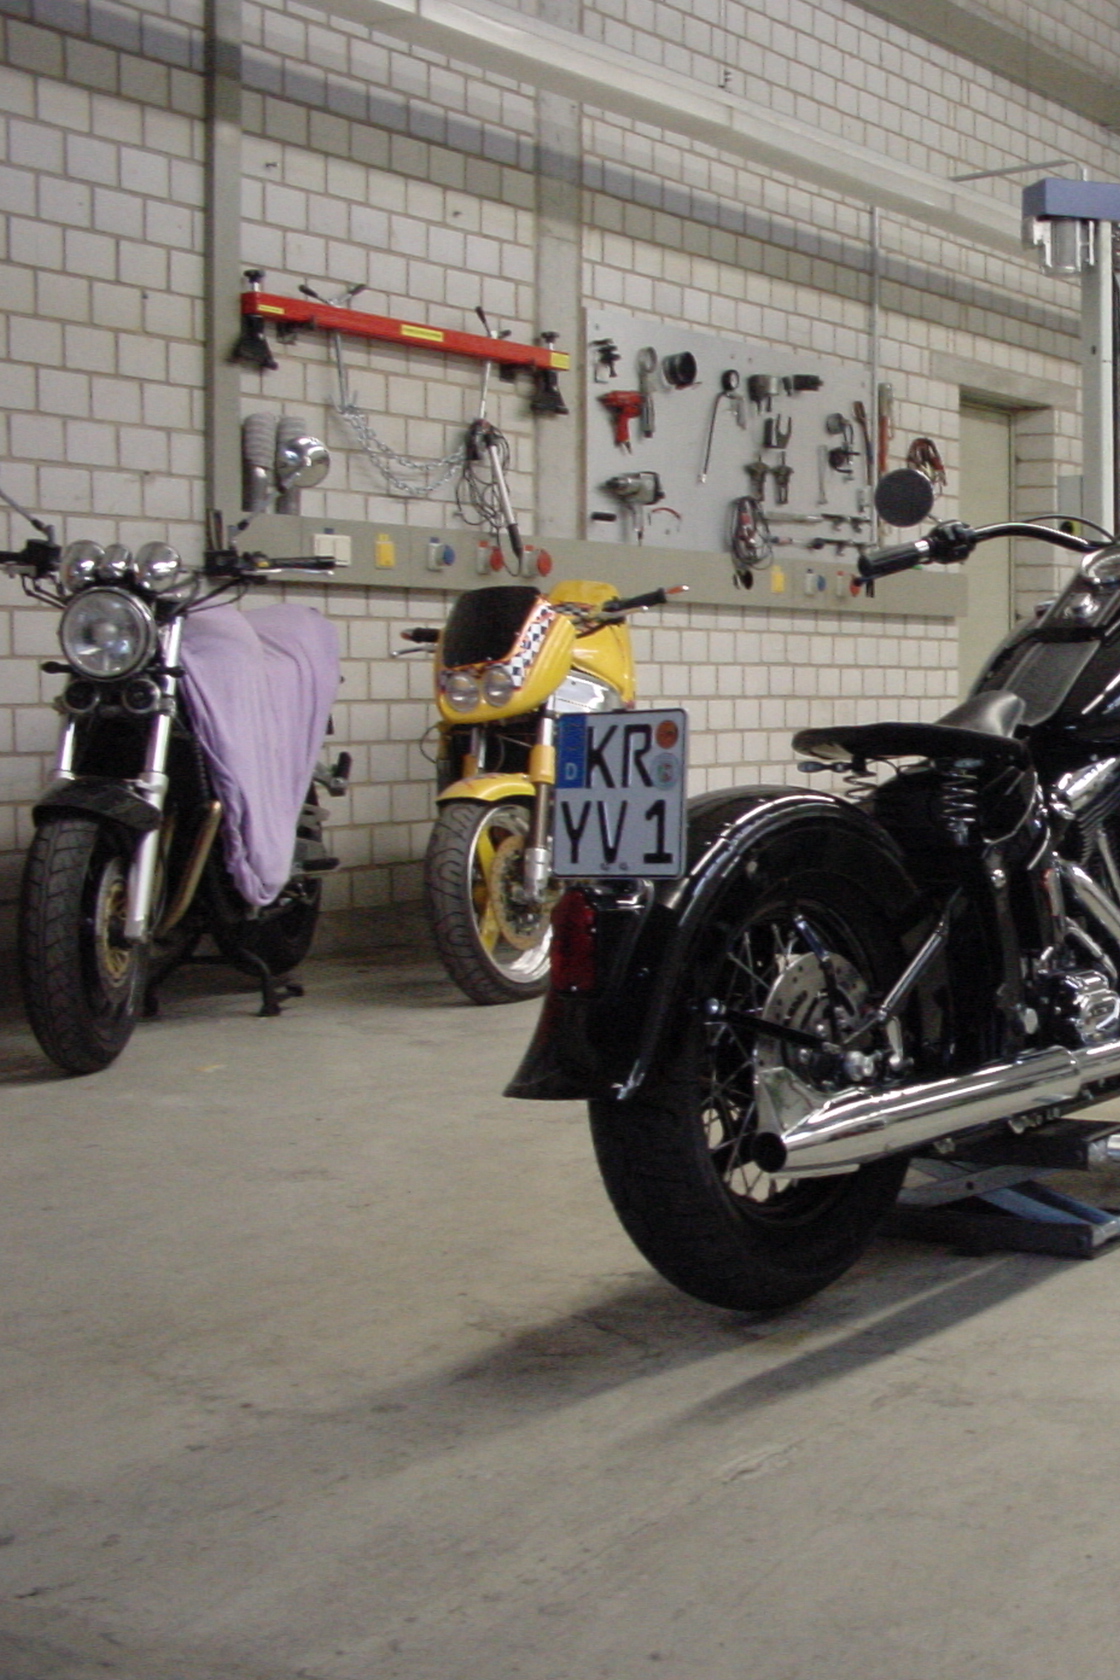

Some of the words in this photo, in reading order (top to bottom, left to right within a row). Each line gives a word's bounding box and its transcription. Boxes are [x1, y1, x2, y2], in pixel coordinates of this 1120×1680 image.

[565, 762, 578, 780] D
[585, 724, 653, 789] KR
[561, 800, 628, 864] YV
[643, 799, 673, 864] 1
